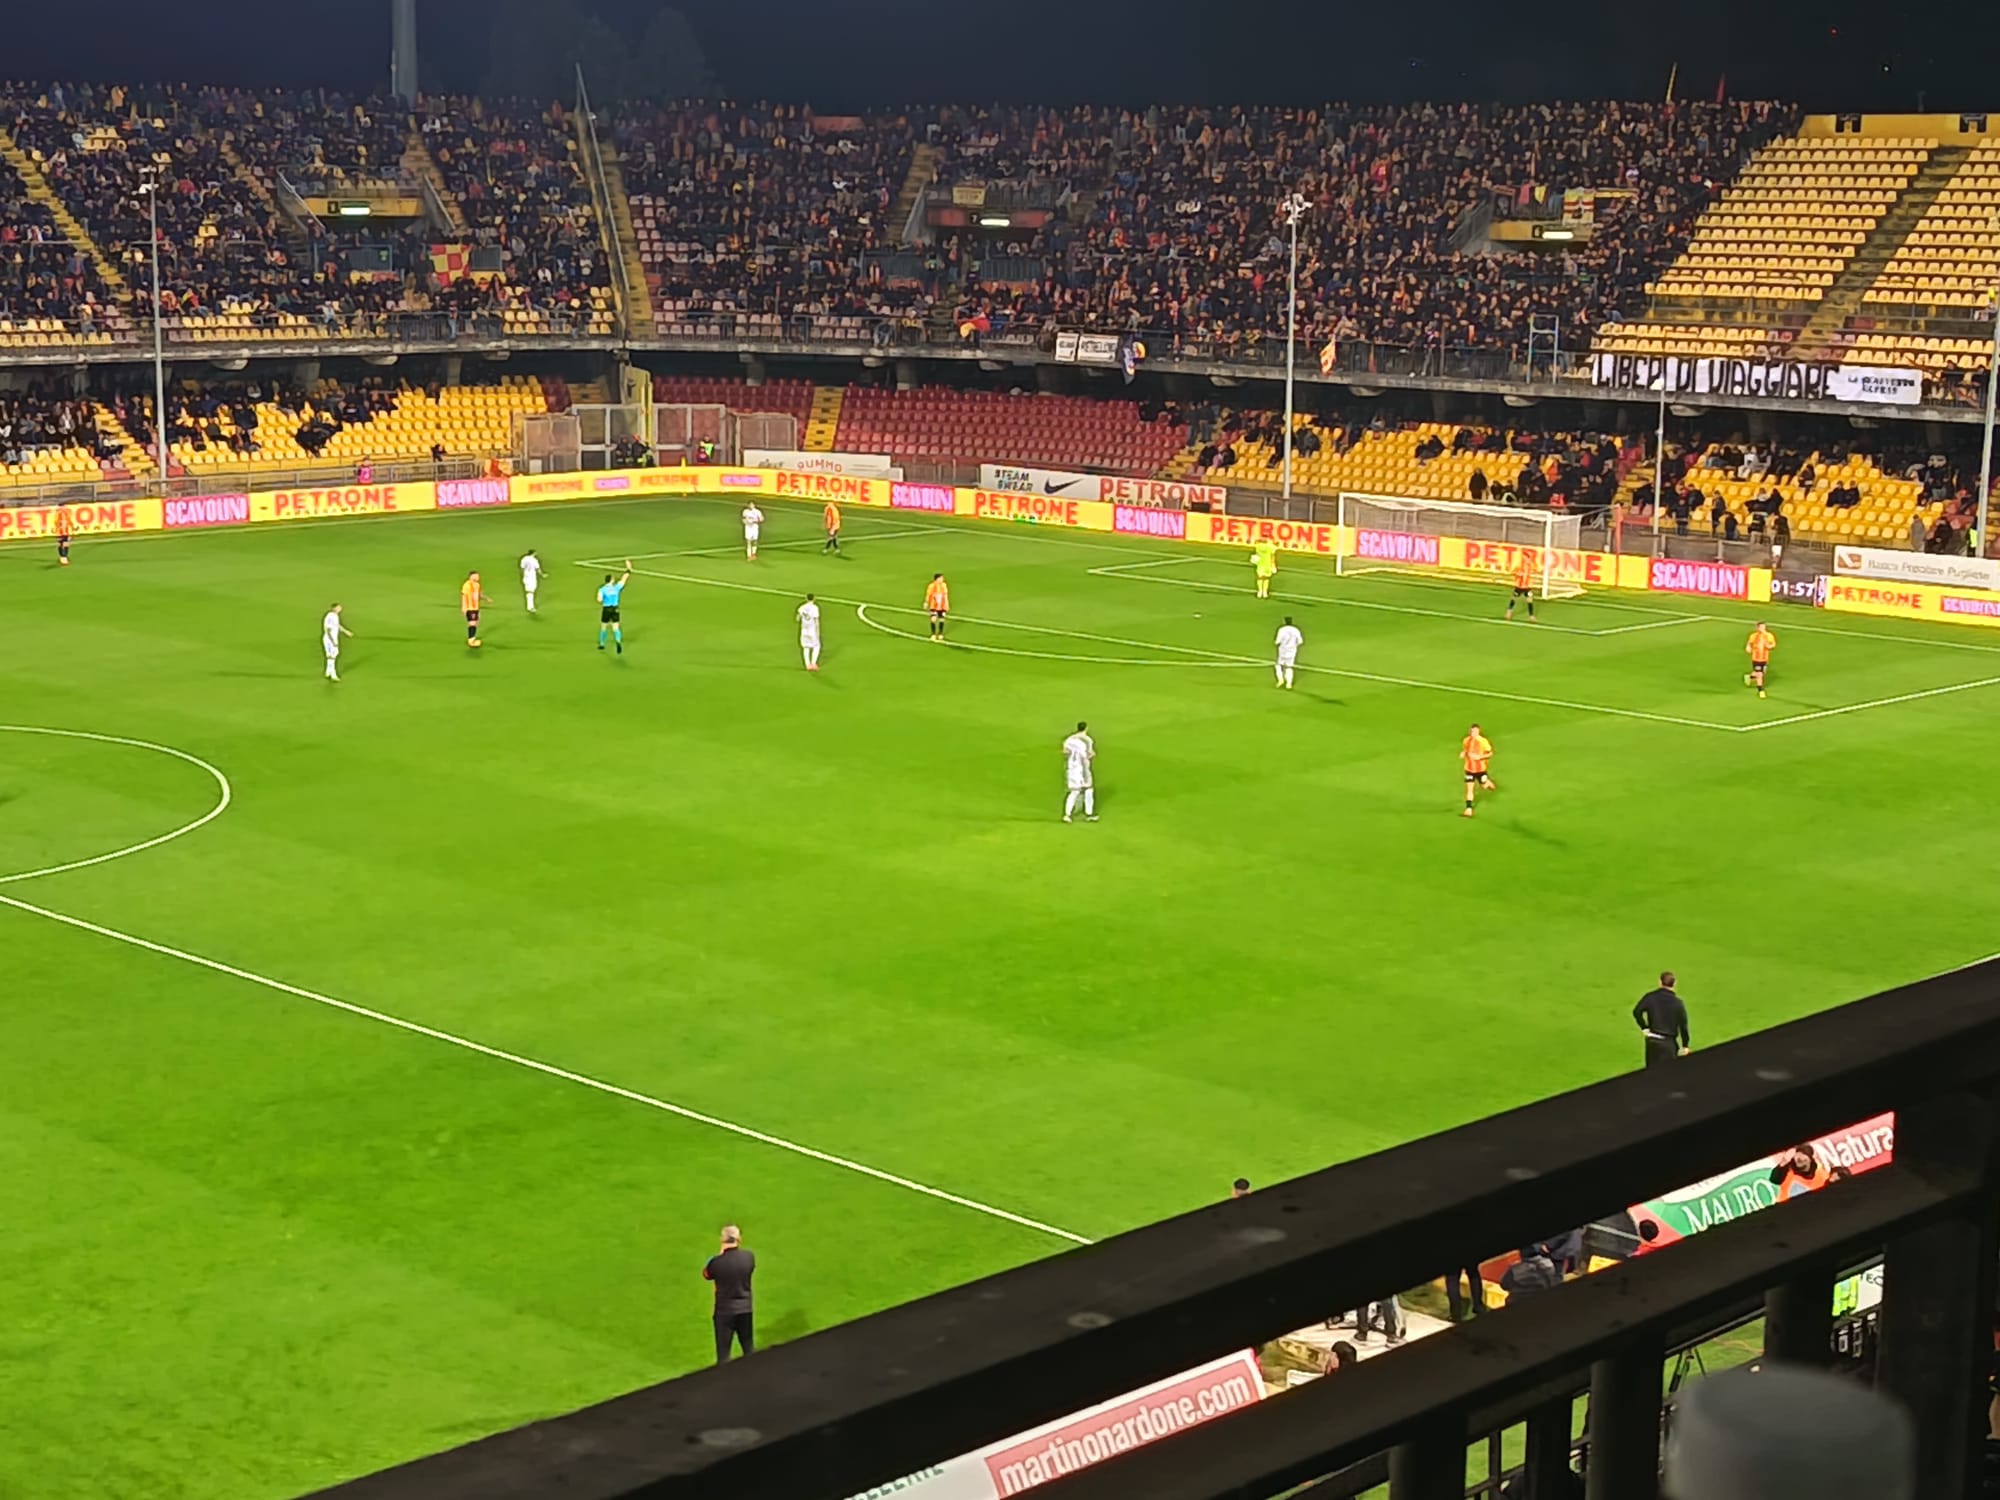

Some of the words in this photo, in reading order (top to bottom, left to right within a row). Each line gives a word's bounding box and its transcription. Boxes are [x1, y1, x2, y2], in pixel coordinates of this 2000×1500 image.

[274, 487, 397, 516] PETRONE
[776, 472, 871, 502] PETRONE
[1100, 478, 1223, 514] PETRONE
[0, 503, 136, 537] PETRONE
[165, 496, 247, 525] SCAVOLINI
[975, 492, 1078, 525] PETRONE
[1210, 517, 1331, 552] PETRONE
[1358, 531, 1437, 563] SCAVOLINI
[1465, 542, 1602, 582] PETRONE
[1652, 562, 1745, 596] SCAVOLINI
[1771, 579, 1815, 597] 01:57
[1831, 586, 1923, 609] PETRONE
[1811, 1126, 1894, 1174] Natura
[1682, 1177, 1778, 1234] MAURO
[1000, 1374, 1250, 1496] martinonardone.com
